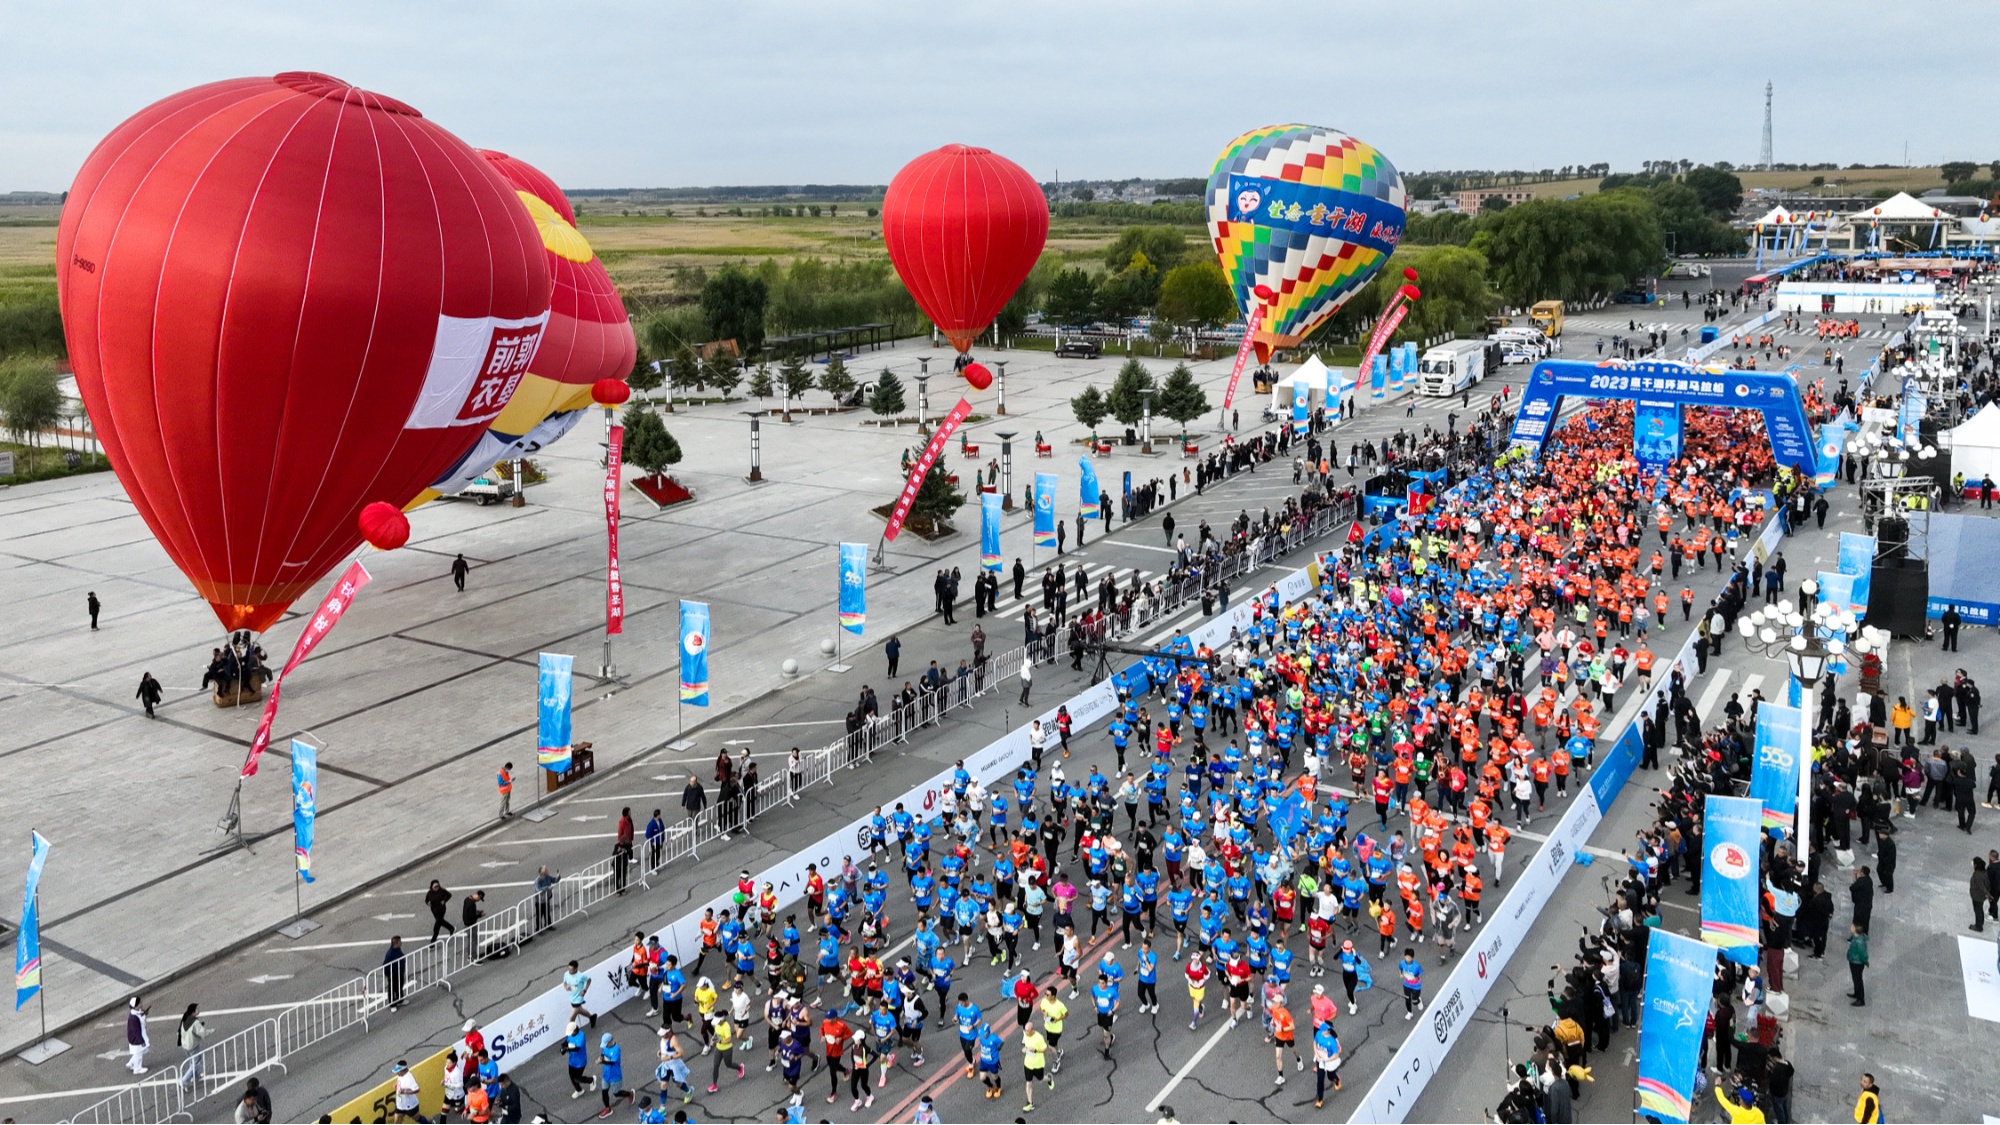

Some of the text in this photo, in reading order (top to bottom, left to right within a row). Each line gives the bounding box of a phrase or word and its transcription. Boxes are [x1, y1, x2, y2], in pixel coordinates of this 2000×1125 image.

[779, 855, 830, 892] AIO
[1443, 988, 1461, 1018] EXPRESS
[1653, 997, 1681, 1013] CHINA
[491, 1023, 551, 1062] ShibaSports
